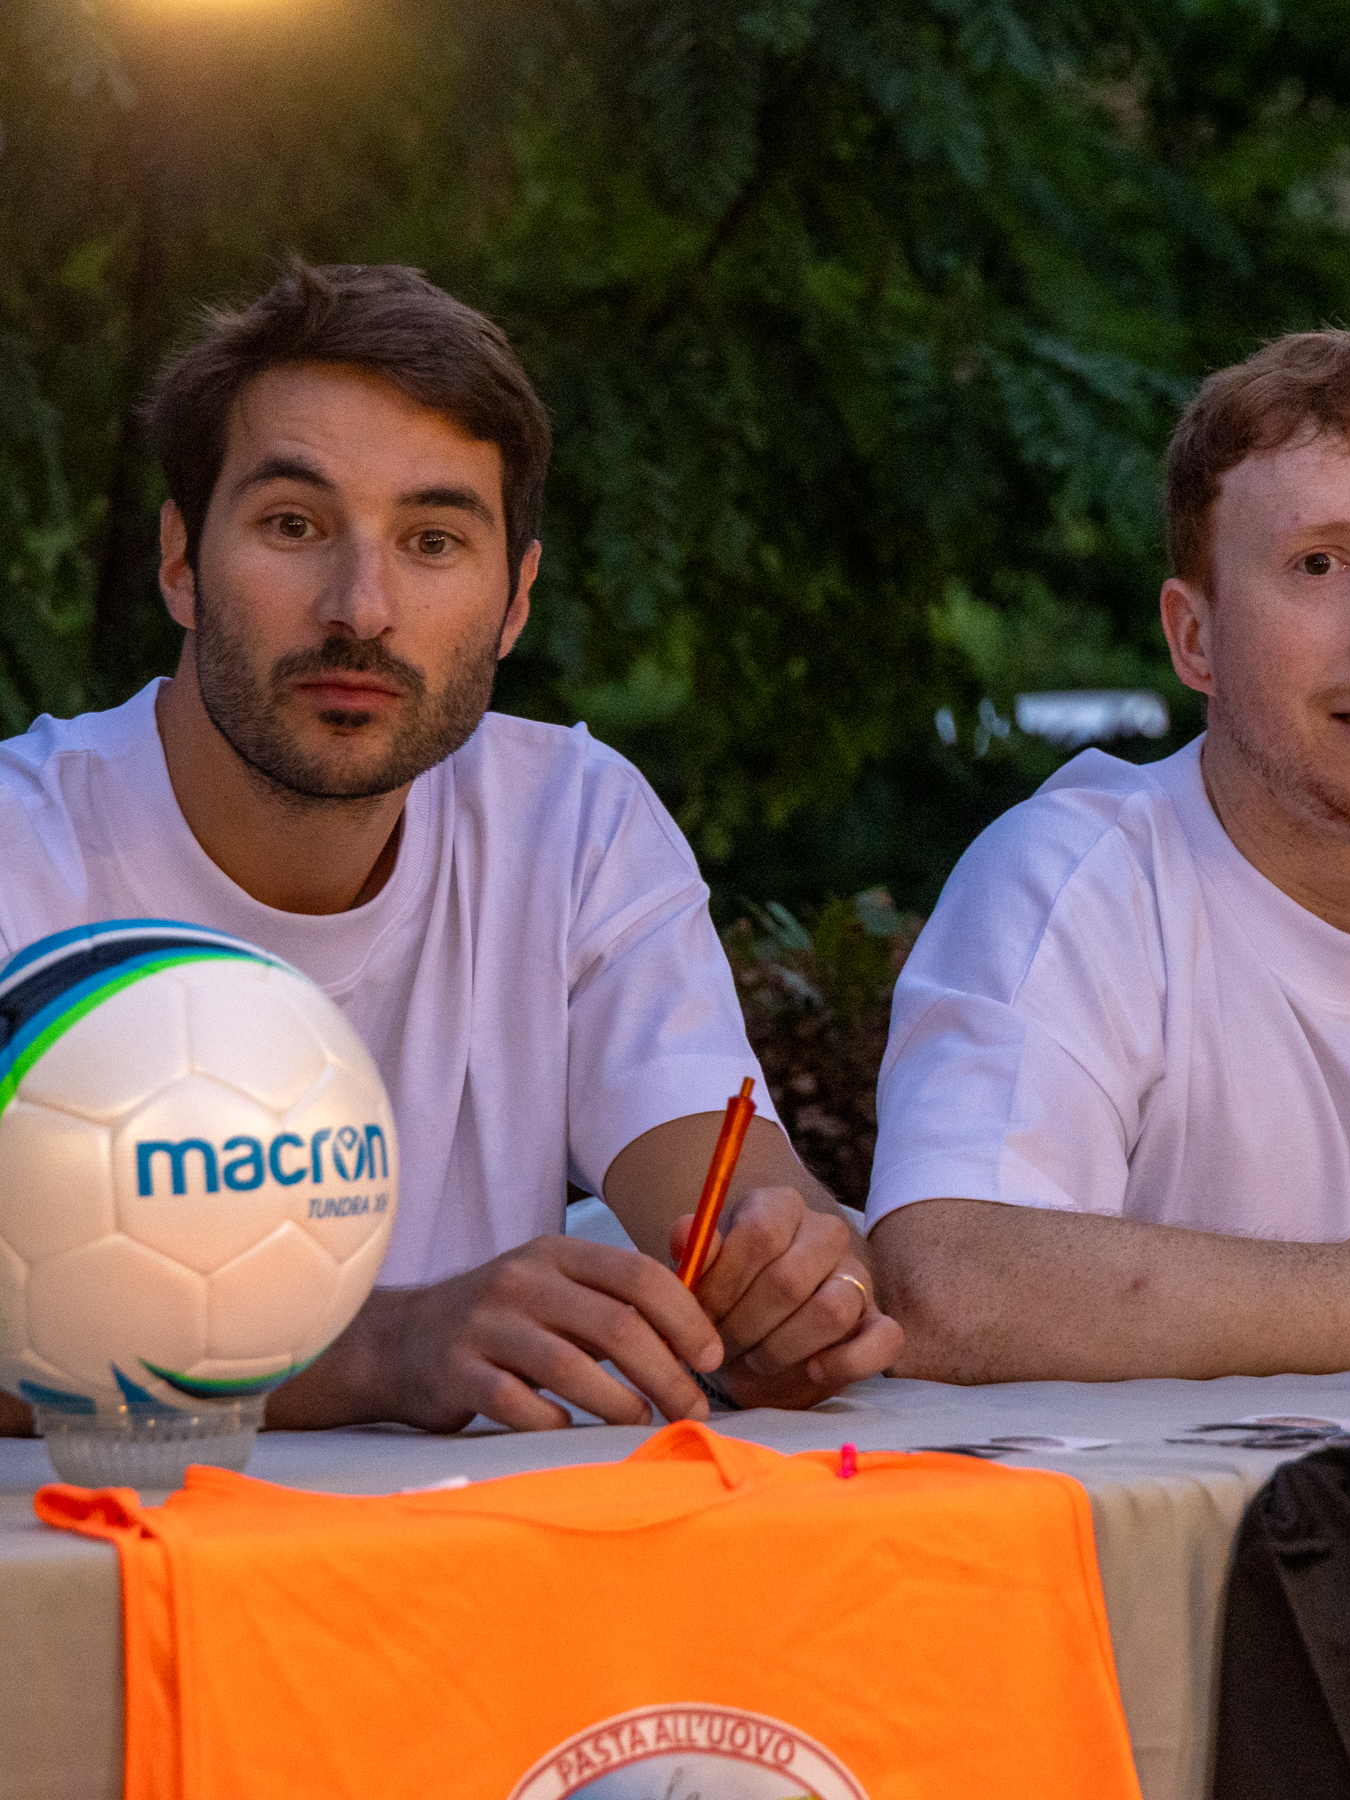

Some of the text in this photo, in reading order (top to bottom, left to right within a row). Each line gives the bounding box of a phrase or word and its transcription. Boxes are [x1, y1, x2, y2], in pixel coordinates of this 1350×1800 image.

[136, 1124, 388, 1197] macron
[308, 1195, 369, 1219] TUNDRA
[555, 1718, 649, 1786] PASTA
[655, 1713, 796, 1767] ALL'UOVO
